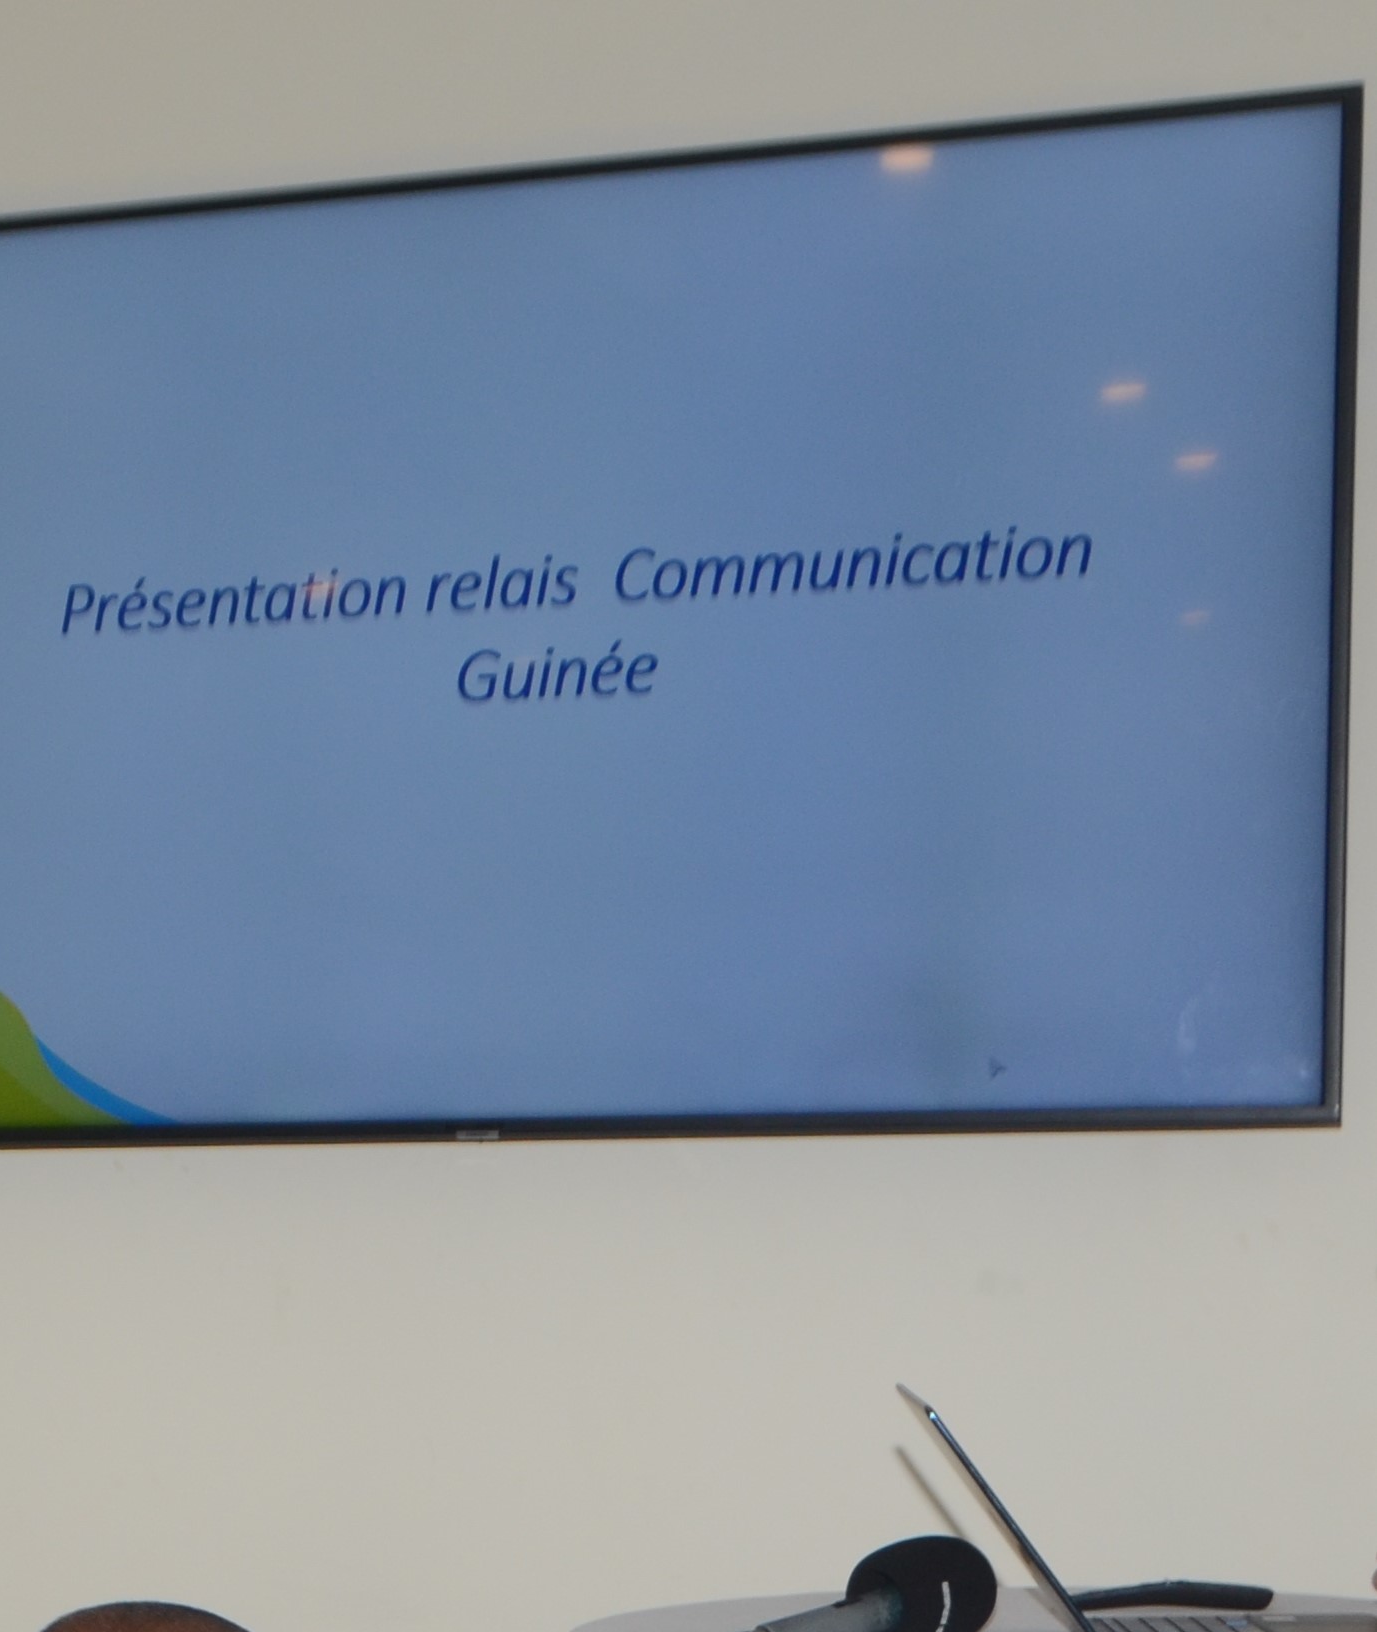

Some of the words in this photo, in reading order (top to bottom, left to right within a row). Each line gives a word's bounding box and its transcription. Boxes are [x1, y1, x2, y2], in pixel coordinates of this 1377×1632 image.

[61, 568, 407, 636] Présentation
[426, 553, 578, 614] relais
[614, 526, 1092, 602] Communication
[457, 639, 658, 702] Guinée
